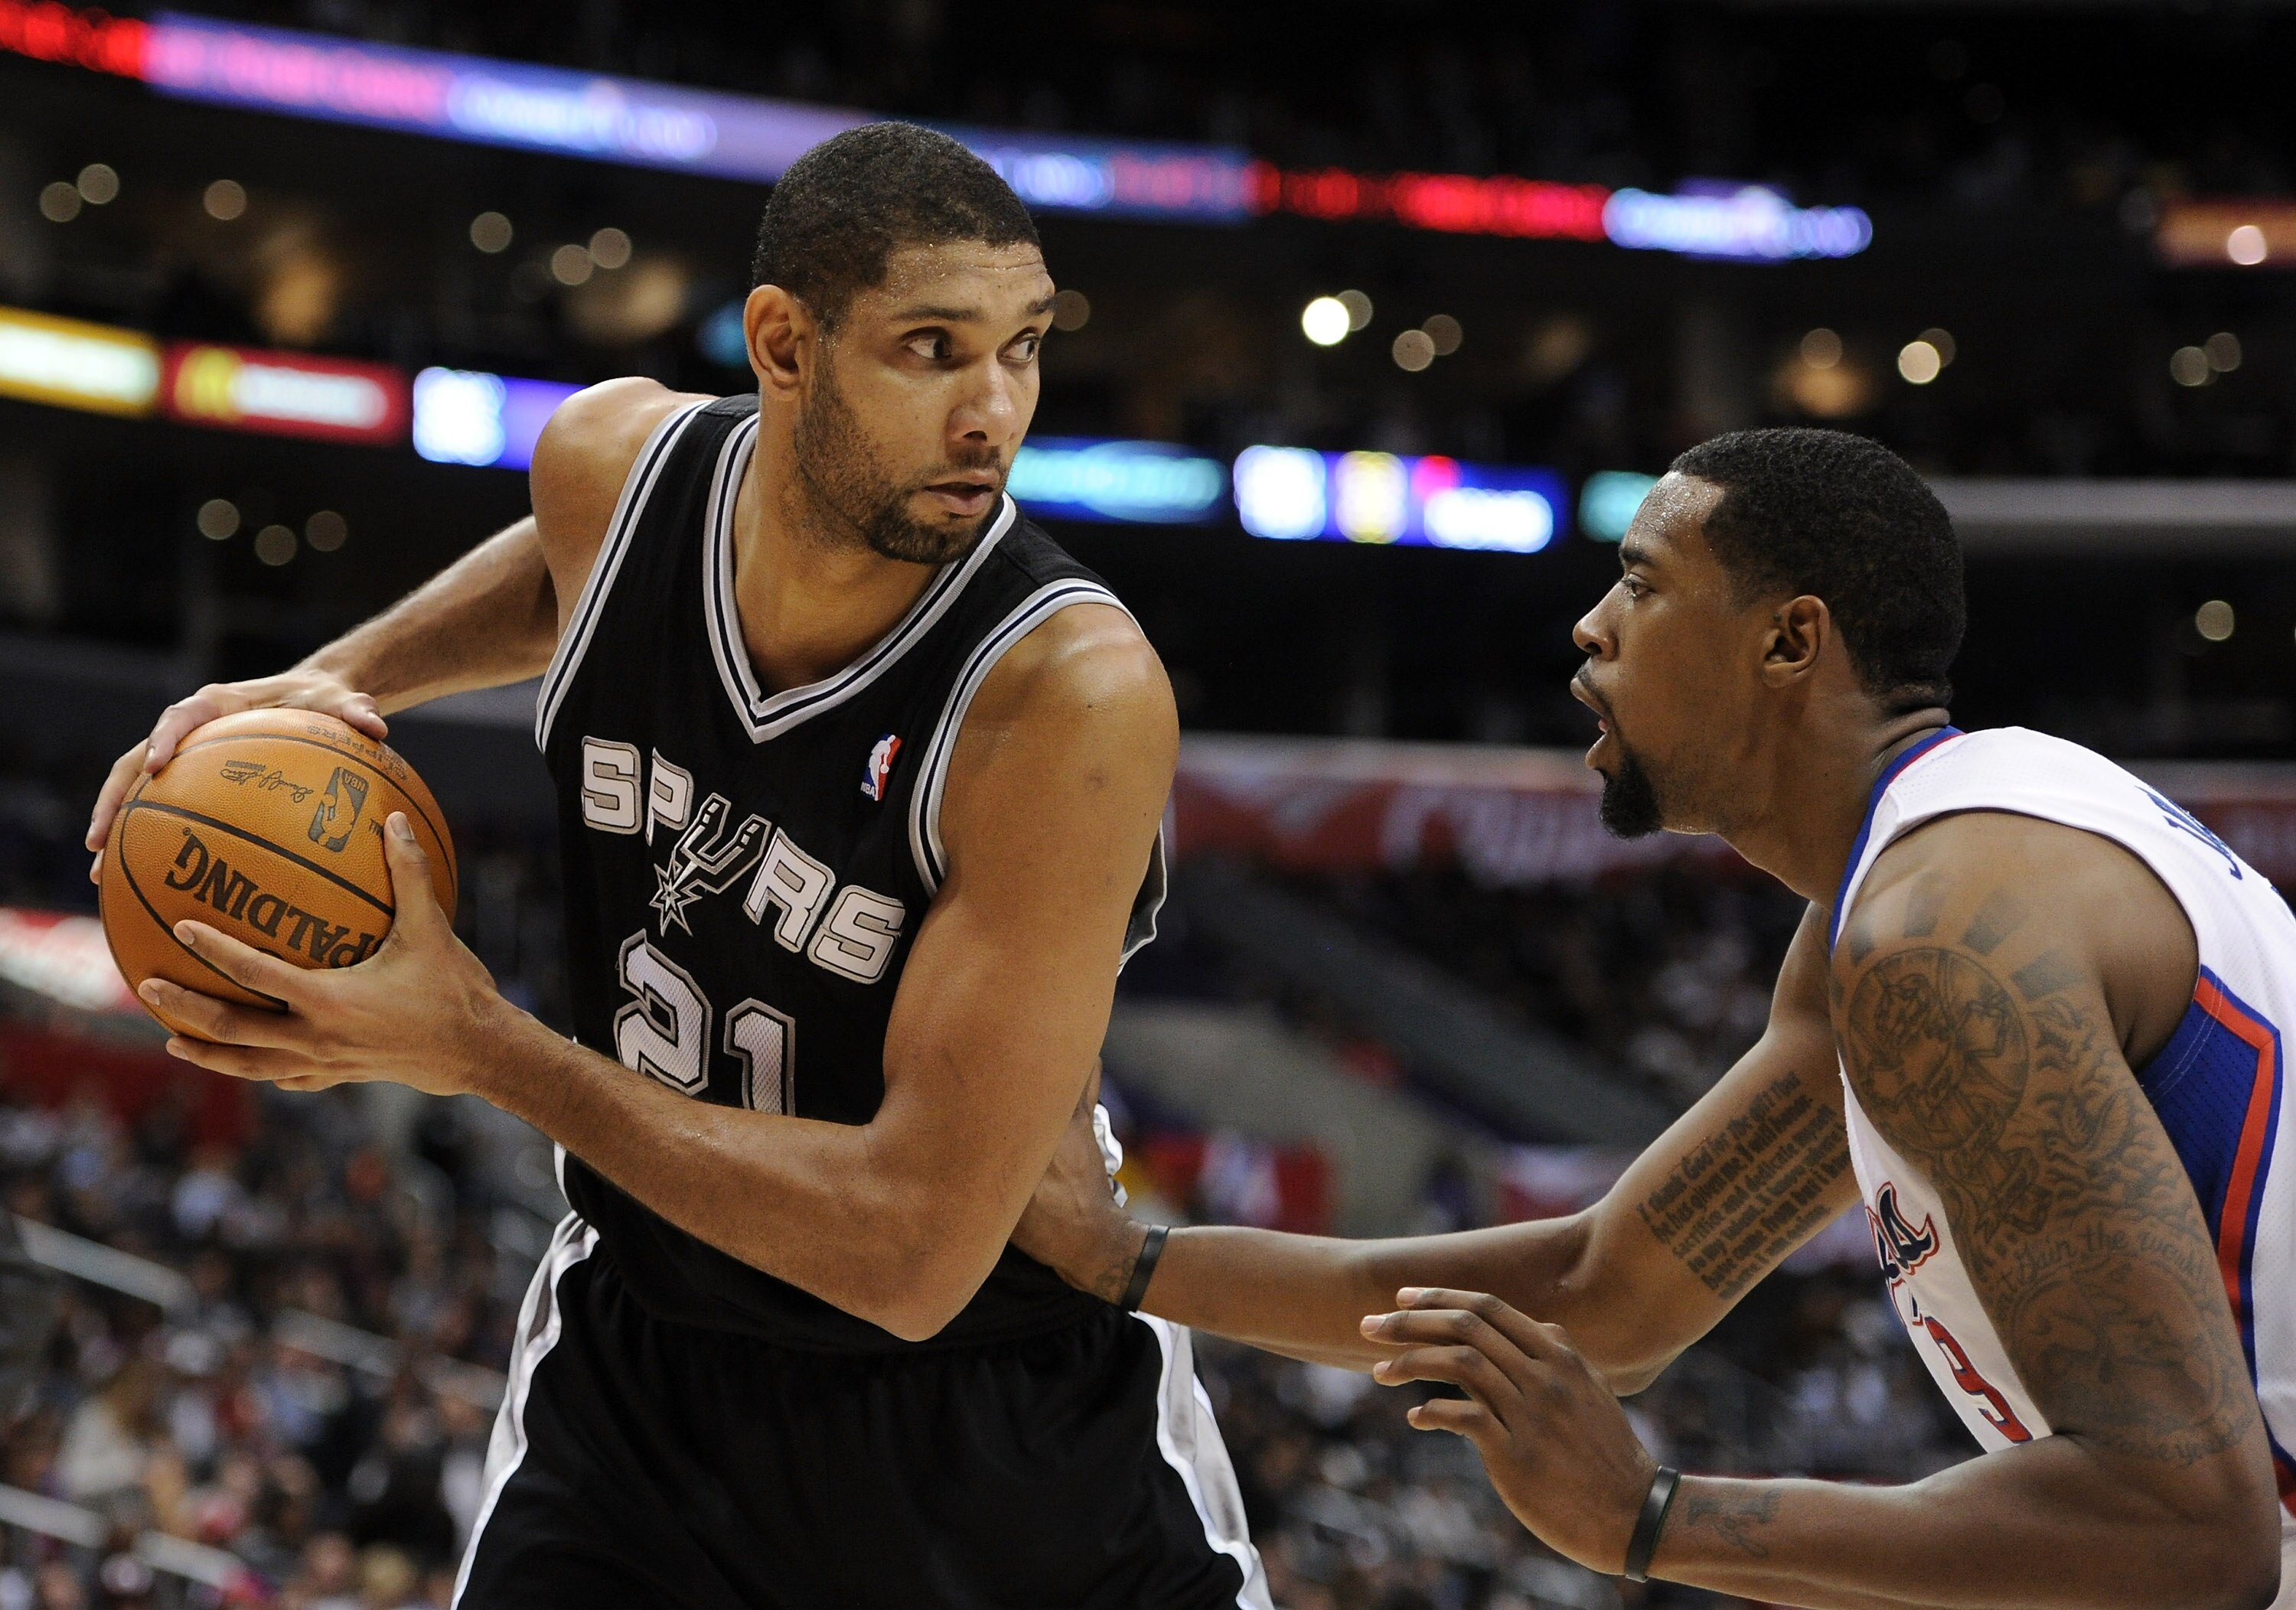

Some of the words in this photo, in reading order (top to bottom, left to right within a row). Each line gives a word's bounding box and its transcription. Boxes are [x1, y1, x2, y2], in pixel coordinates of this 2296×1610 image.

[344, 772, 367, 791] NBA
[860, 781, 875, 797] NBA
[164, 833, 385, 969] PALDING
[582, 735, 905, 984] SPURS
[614, 929, 795, 1115] 21
